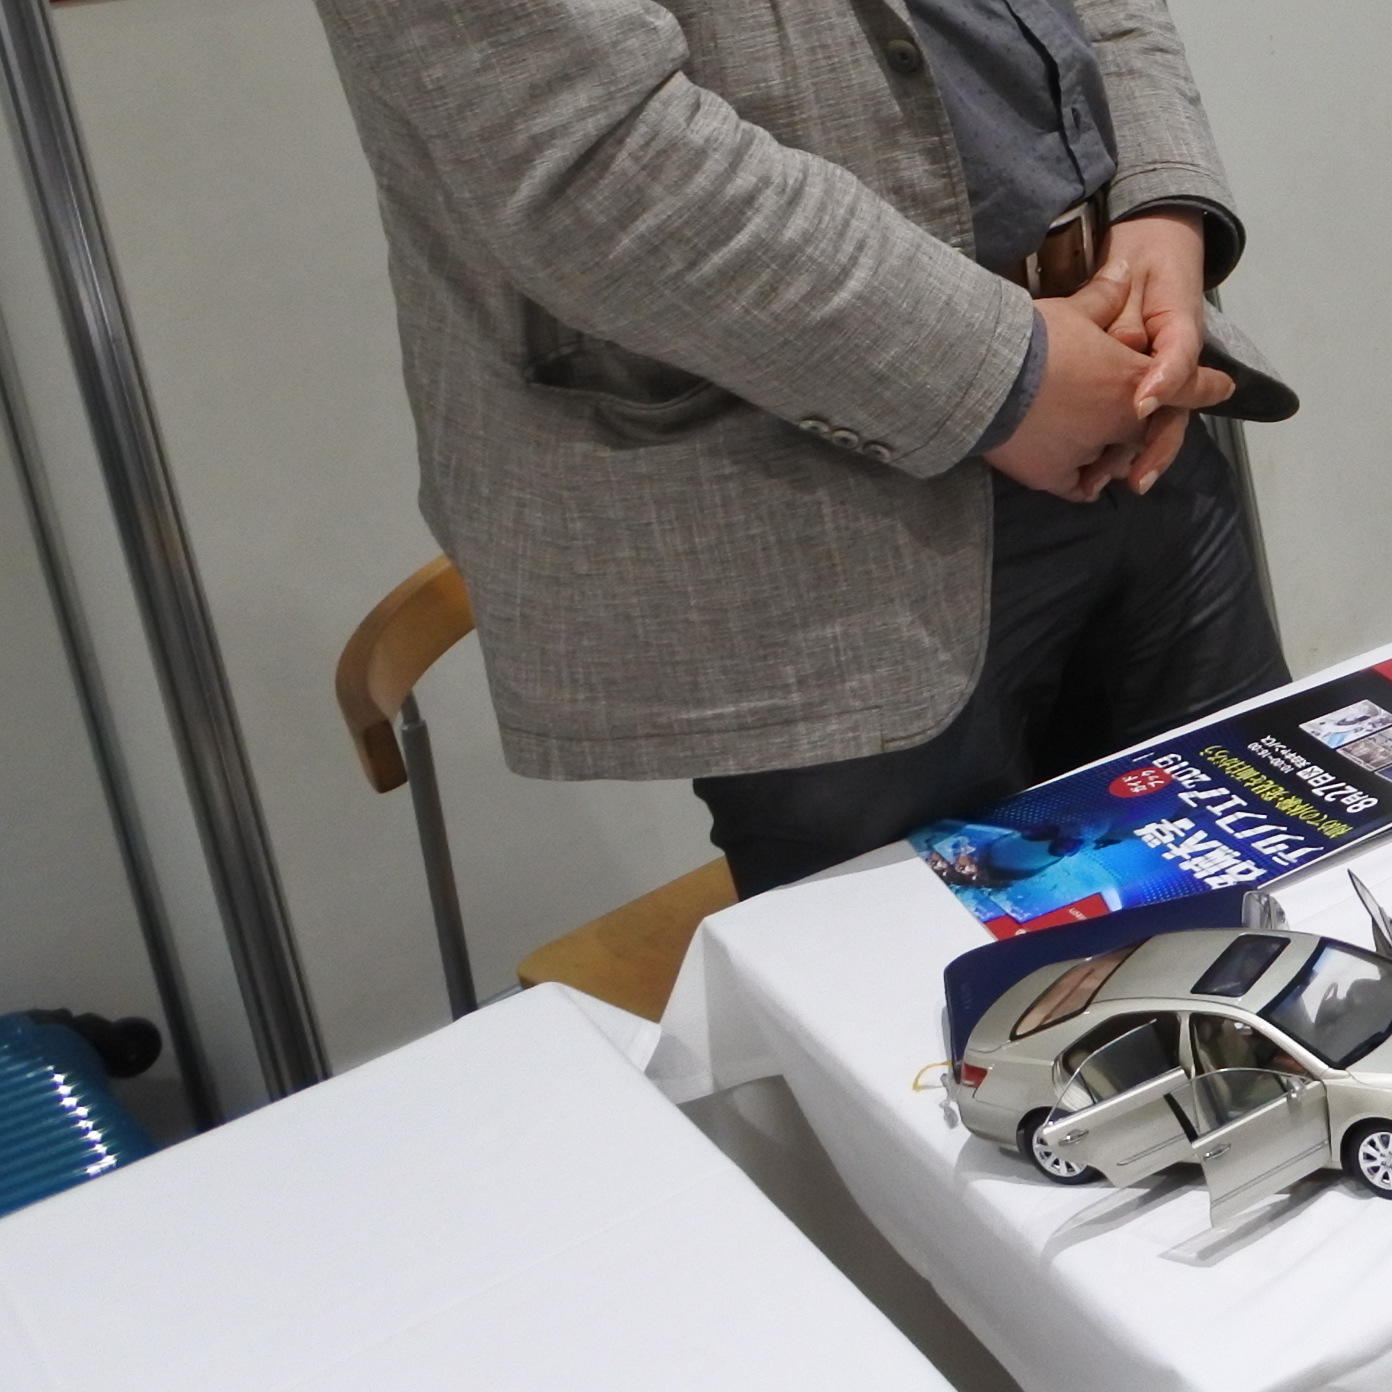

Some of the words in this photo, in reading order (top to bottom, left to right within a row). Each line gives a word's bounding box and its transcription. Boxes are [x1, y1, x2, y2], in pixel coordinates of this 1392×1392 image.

[1121, 773, 1148, 794] ガイド
[1140, 769, 1165, 788] ブック
[1151, 752, 1213, 789] 2019
[1177, 786, 1325, 866] テクノフェア
[1133, 816, 1268, 890] 名城大学
